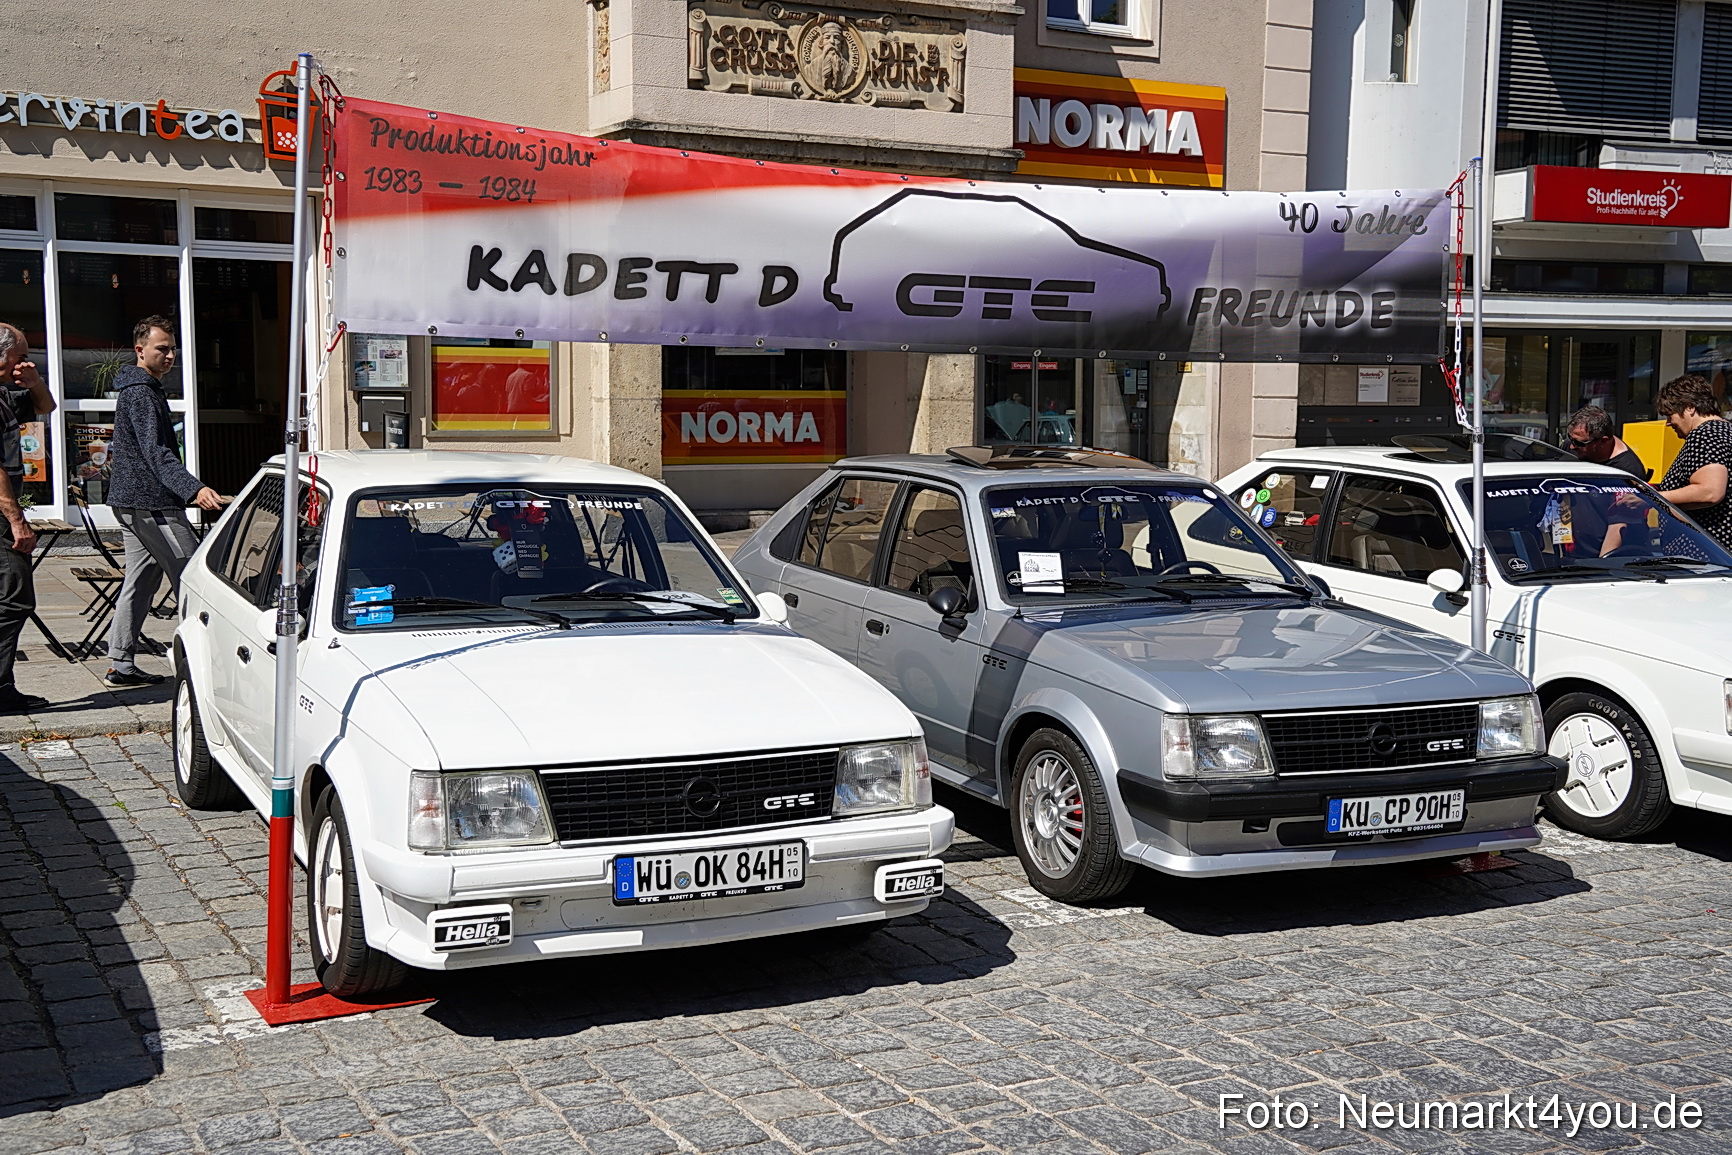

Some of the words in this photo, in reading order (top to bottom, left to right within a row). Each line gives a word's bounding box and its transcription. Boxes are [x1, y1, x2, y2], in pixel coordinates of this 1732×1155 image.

[1016, 96, 1203, 156] NORMA
[369, 117, 598, 171] Produktionsjahr
[364, 166, 423, 194] 1983
[479, 175, 537, 203] 1984
[1587, 187, 1667, 207] Studienkreis
[1279, 202, 1319, 233] 40
[1331, 204, 1427, 235] Jahre
[1596, 206, 1638, 215] Profi-Nachhilfe
[1638, 207, 1647, 216] für
[466, 245, 739, 303] KADETT
[758, 265, 799, 307] D
[896, 273, 1095, 323] GTE
[1187, 287, 1396, 329] FREUNDE
[681, 411, 821, 443] NORMA
[1486, 488, 1530, 498] KADETT
[1554, 486, 1589, 494] GTE
[1602, 486, 1640, 494] FREUNDE
[391, 501, 456, 511] KADETT
[496, 500, 552, 508] GTE
[577, 501, 643, 510] FREUNDE
[1016, 497, 1066, 507] KADETT
[1071, 496, 1079, 504] D
[1098, 495, 1140, 503] GTE
[1493, 629, 1525, 644] GTE
[982, 654, 1008, 671] GTE
[299, 694, 315, 715] GTE
[1588, 699, 1621, 719] GOOD
[1621, 723, 1642, 759] YEAR
[1427, 739, 1464, 751] GTE
[763, 793, 815, 810] GTE
[1452, 793, 1462, 802] 05
[1342, 801, 1369, 828] KU
[1384, 798, 1411, 824] CP
[1415, 794, 1451, 822] 90H
[1451, 810, 1460, 819] 10
[1331, 818, 1337, 826] D
[1347, 829, 1389, 837] KFZ-Werkstatt
[786, 847, 798, 857] 05
[694, 854, 728, 887] OK
[736, 849, 784, 883] 84H
[787, 868, 798, 878] 10
[621, 882, 629, 892] D
[893, 875, 935, 892] Hella
[445, 923, 500, 942] Hella
